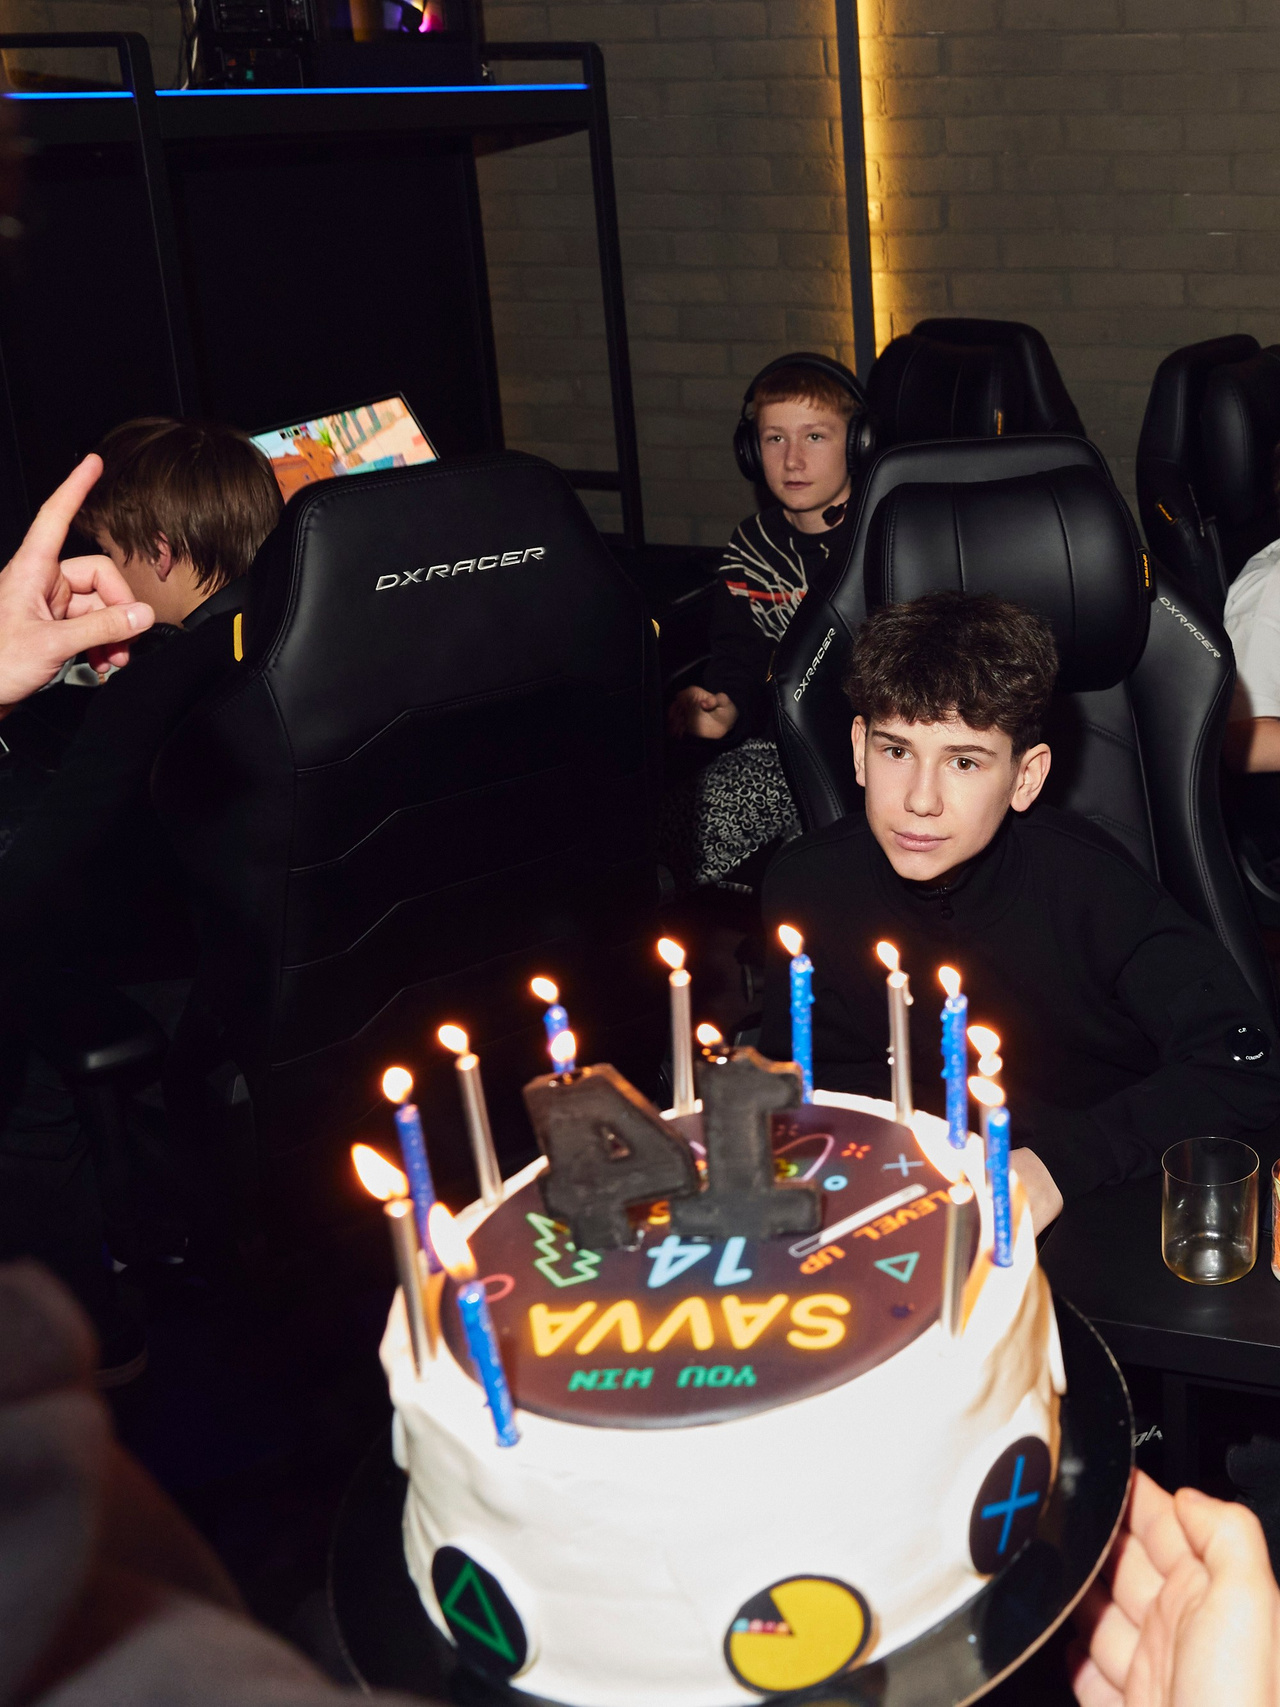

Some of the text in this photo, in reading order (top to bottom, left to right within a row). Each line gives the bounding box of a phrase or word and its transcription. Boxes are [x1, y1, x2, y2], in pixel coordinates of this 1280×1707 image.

[375, 546, 547, 591] DXRACER
[1159, 596, 1222, 658] DXRACER
[793, 627, 836, 702] DXRACER
[647, 1234, 753, 1288] 14
[798, 1190, 951, 1276] LEVEL UP
[528, 1293, 852, 1357] SAVVA
[567, 1365, 757, 1393] YOU WIN
